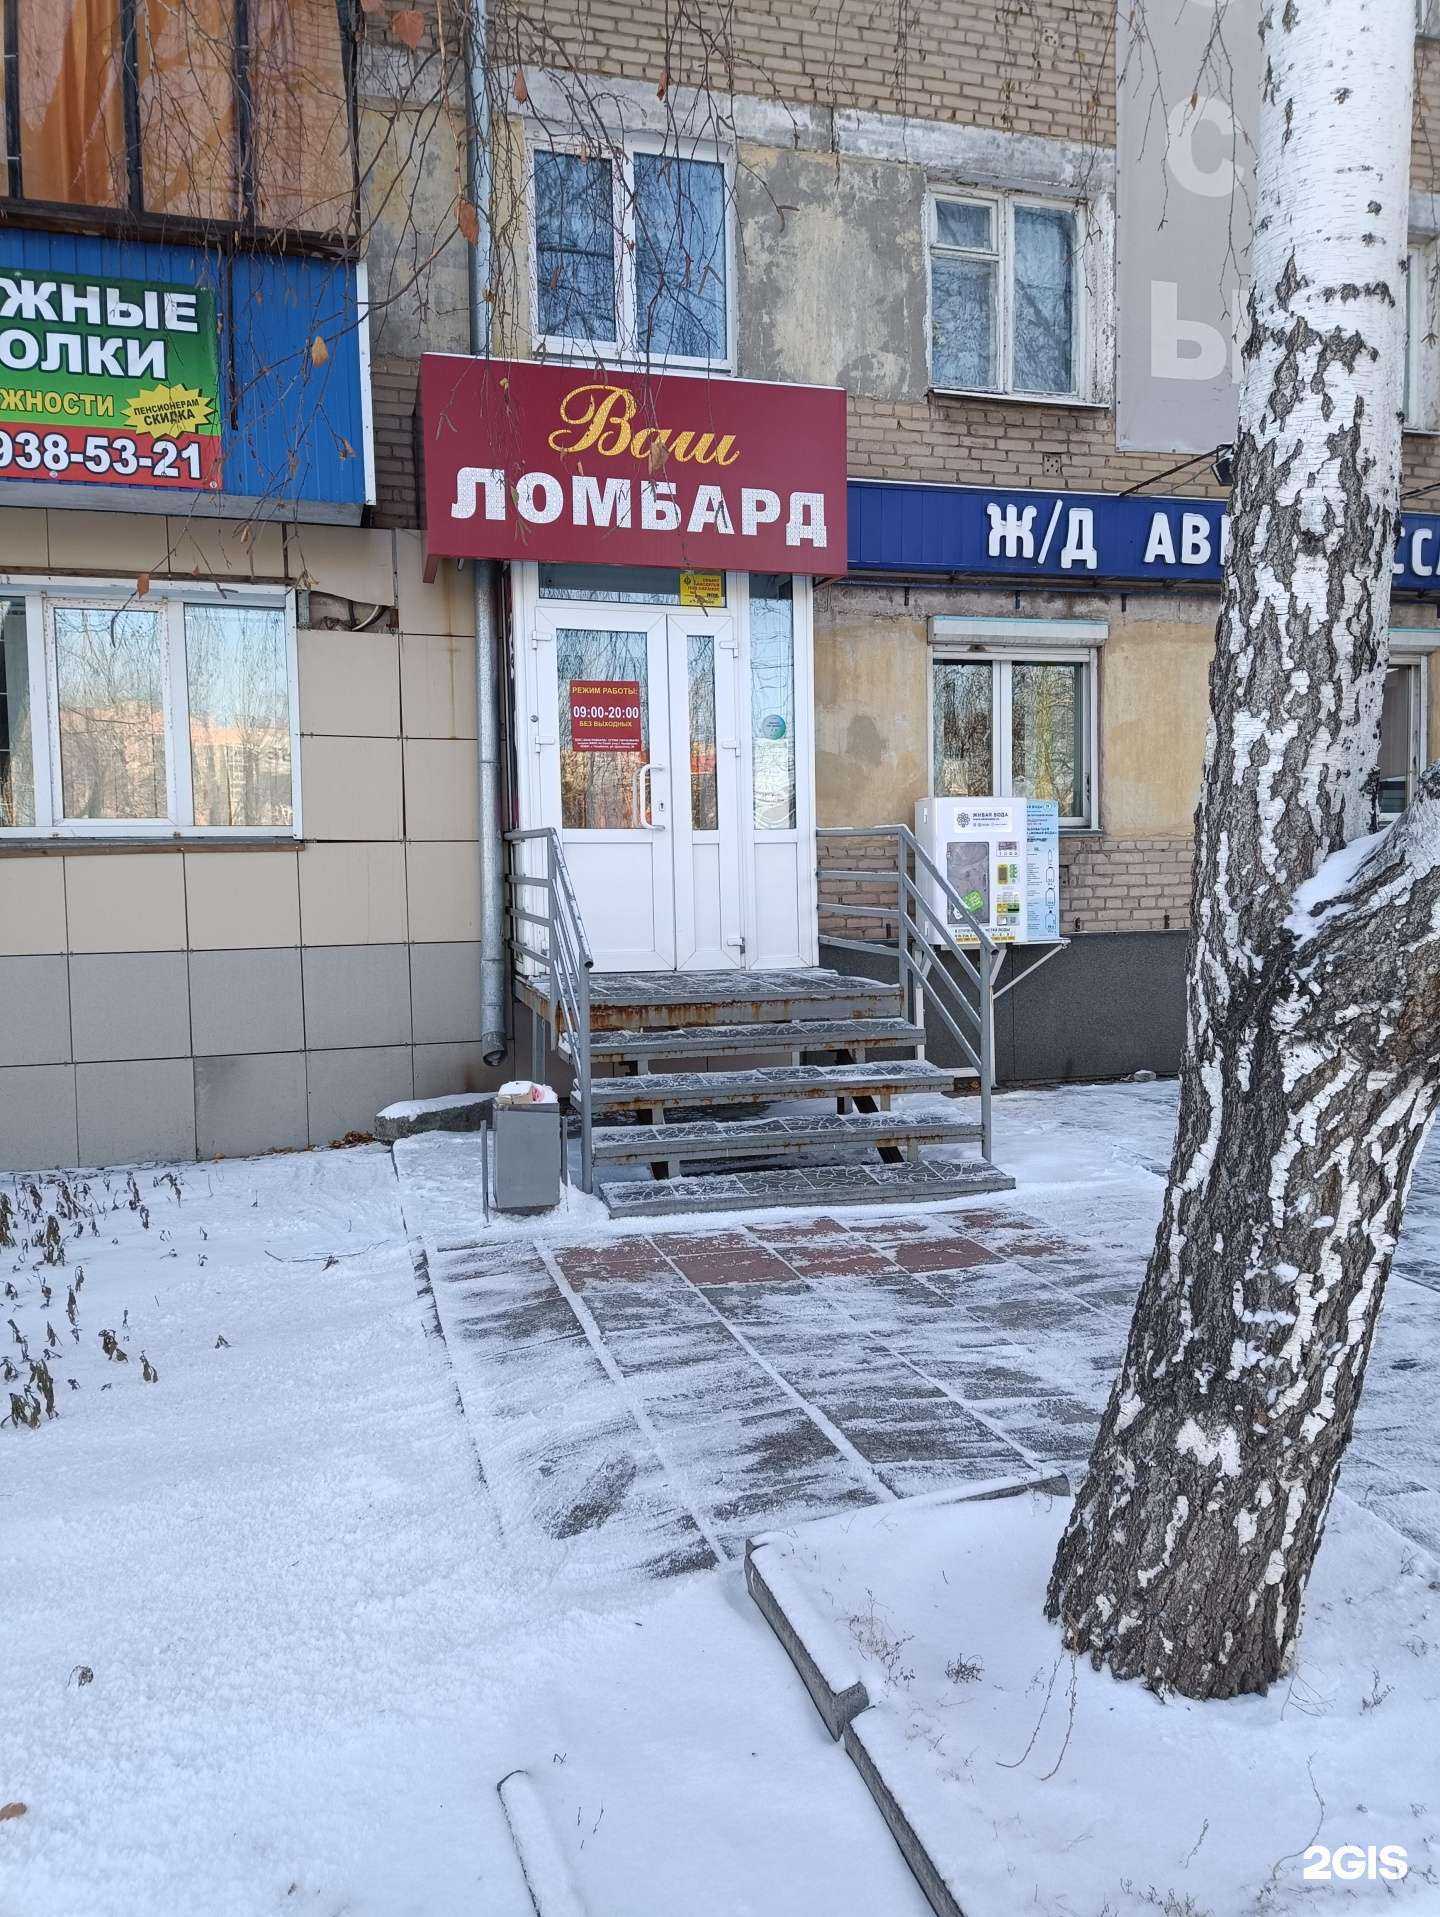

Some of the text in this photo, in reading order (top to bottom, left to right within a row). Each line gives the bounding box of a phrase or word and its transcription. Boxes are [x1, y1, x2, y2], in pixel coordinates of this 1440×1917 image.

[0, 277, 198, 333] ЖНЫЕ
[0, 329, 168, 379] ОЛКИ
[0, 387, 114, 417] ЖНОСТИ
[133, 398, 200, 416] ПЕНСИОНЕРАМ
[143, 408, 196, 426] СКИДКА
[548, 384, 740, 466] Ваш
[451, 466, 828, 549] ЛОМБАРД
[987, 498, 1098, 570] Ж/Д
[1144, 511, 1230, 566] АВ
[572, 686, 601, 695] РЕЖИМ
[573, 705, 639, 719] 09:00-20:00
[579, 720, 632, 729] БЕЗ ВЫХОДНЫХ
